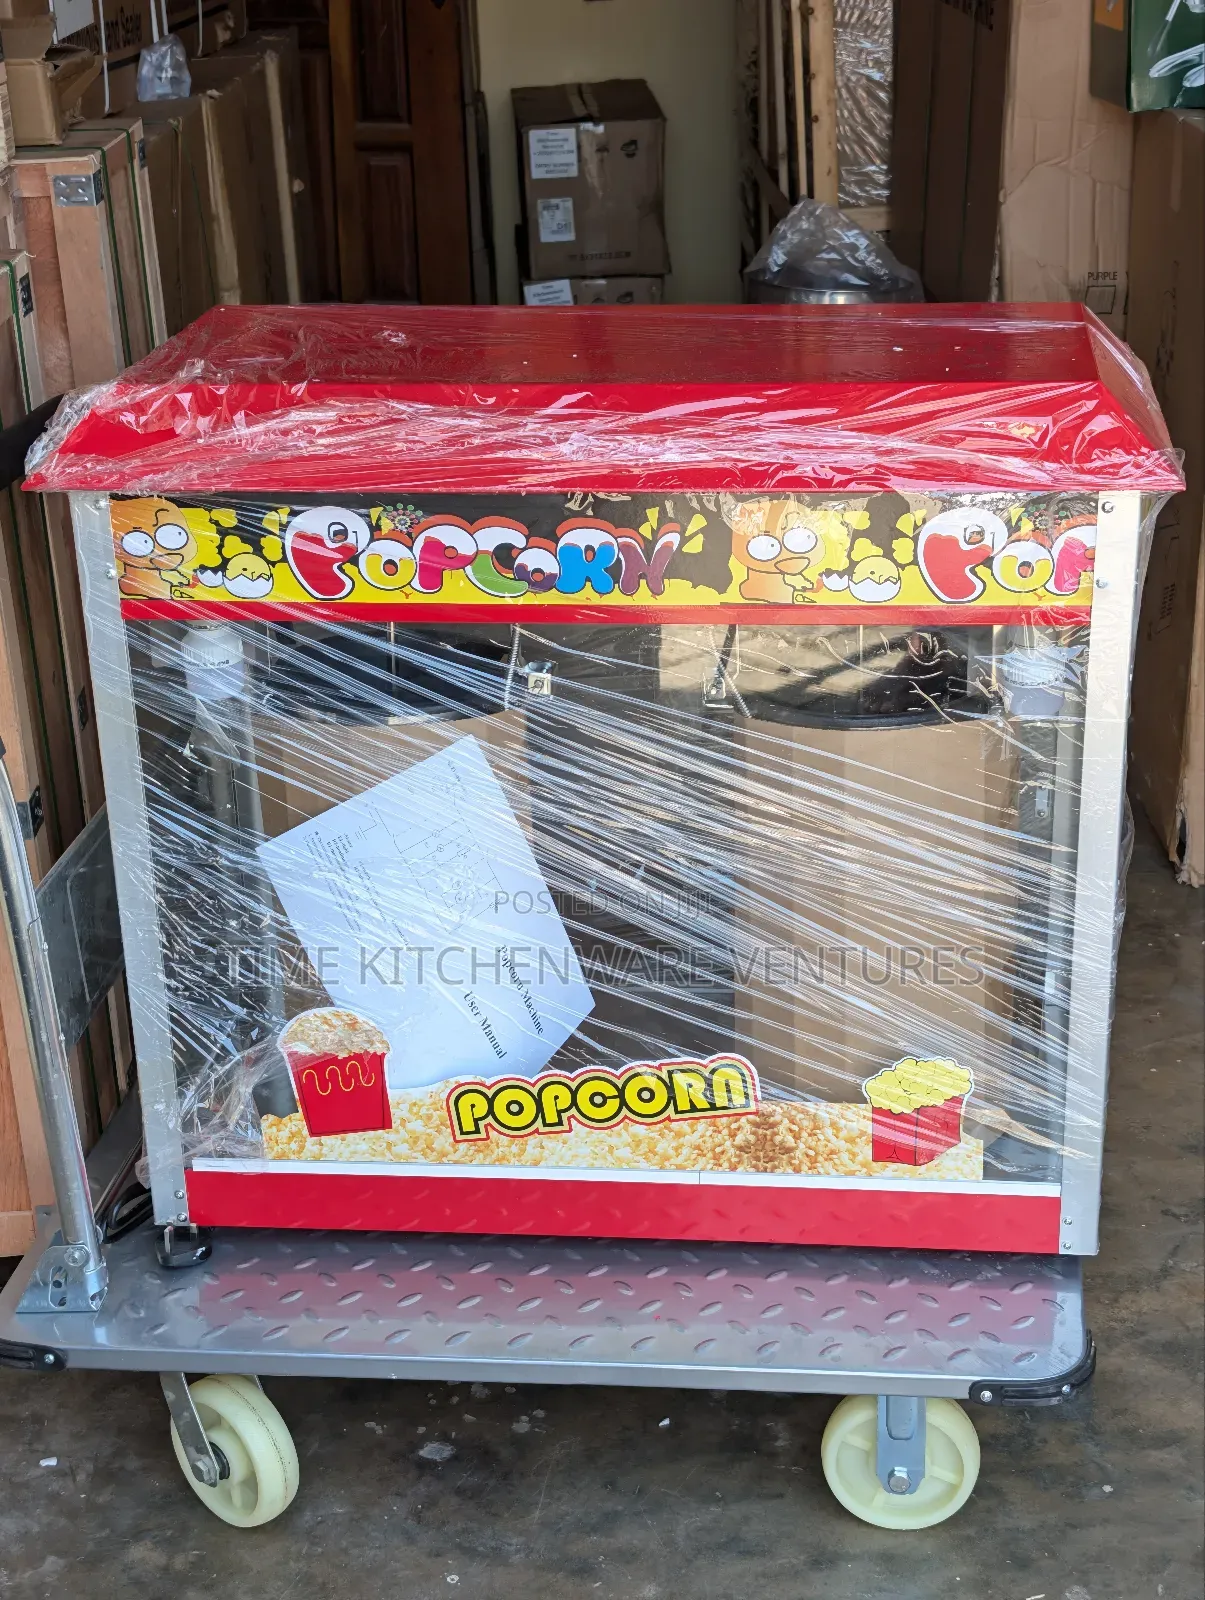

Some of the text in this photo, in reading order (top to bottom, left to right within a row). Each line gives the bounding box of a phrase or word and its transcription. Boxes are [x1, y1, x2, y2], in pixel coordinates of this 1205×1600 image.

[1087, 271, 1118, 281] PURPLE
[284, 506, 681, 601] POPCORN
[463, 990, 508, 1059] User Manual
[497, 944, 544, 1035] Popcorn Machine
[452, 1065, 750, 1136] POPCORN
